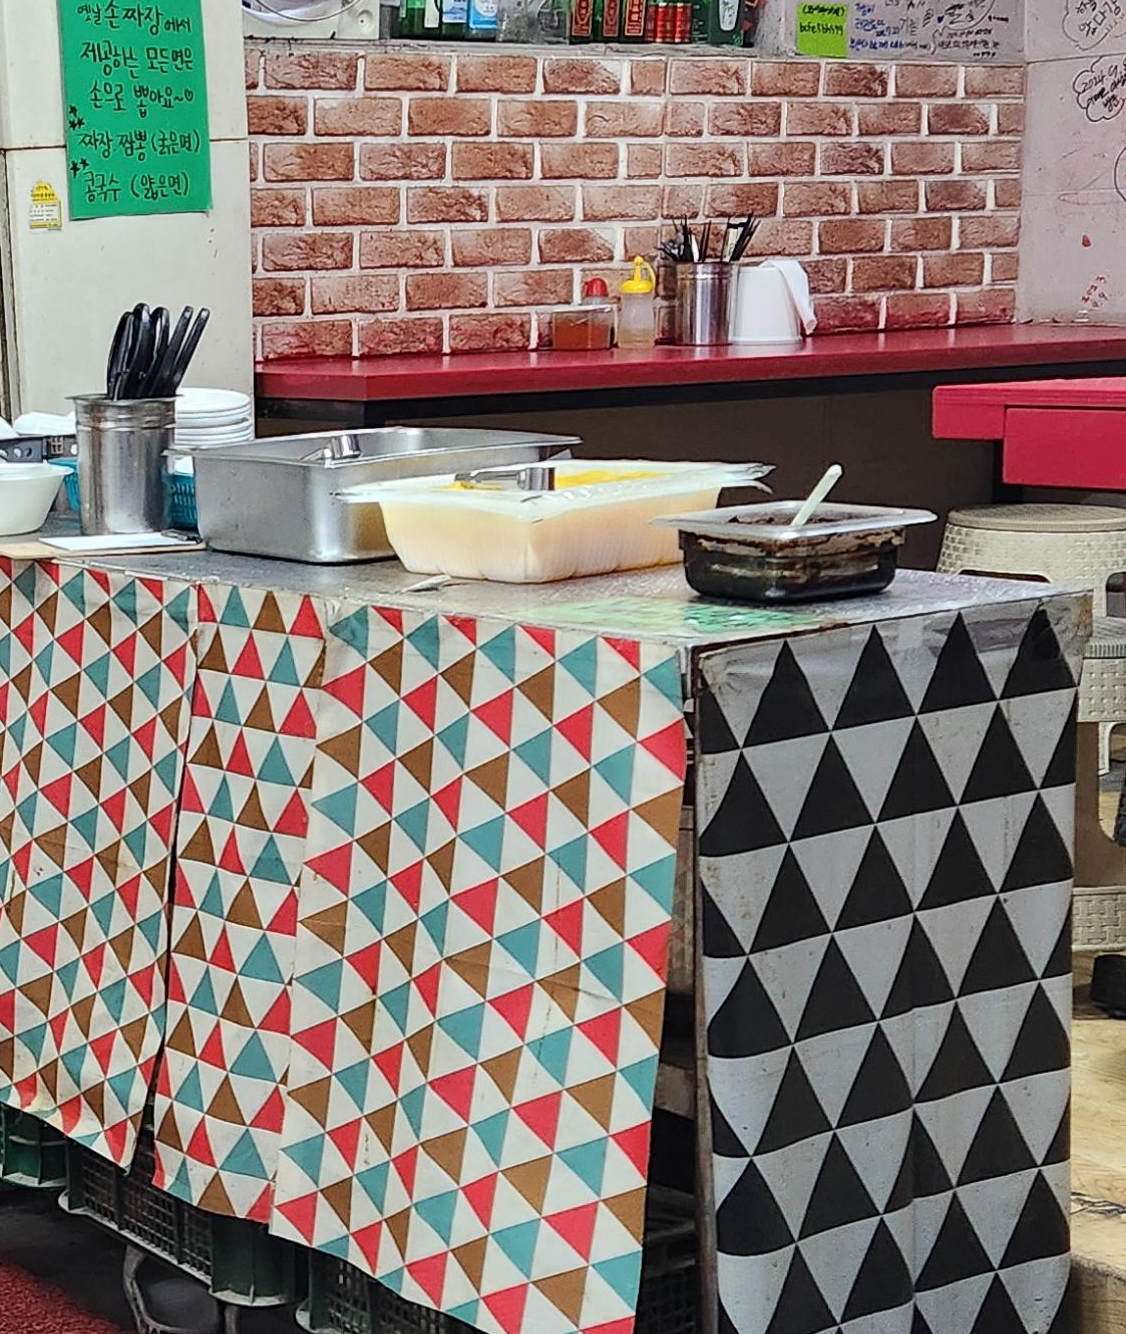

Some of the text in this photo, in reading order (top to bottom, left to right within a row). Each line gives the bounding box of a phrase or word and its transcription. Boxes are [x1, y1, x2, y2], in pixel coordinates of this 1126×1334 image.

[80, 40, 140, 79] 제공하는
[89, 80, 127, 112] 손으로
[83, 170, 122, 203] 콩국수
